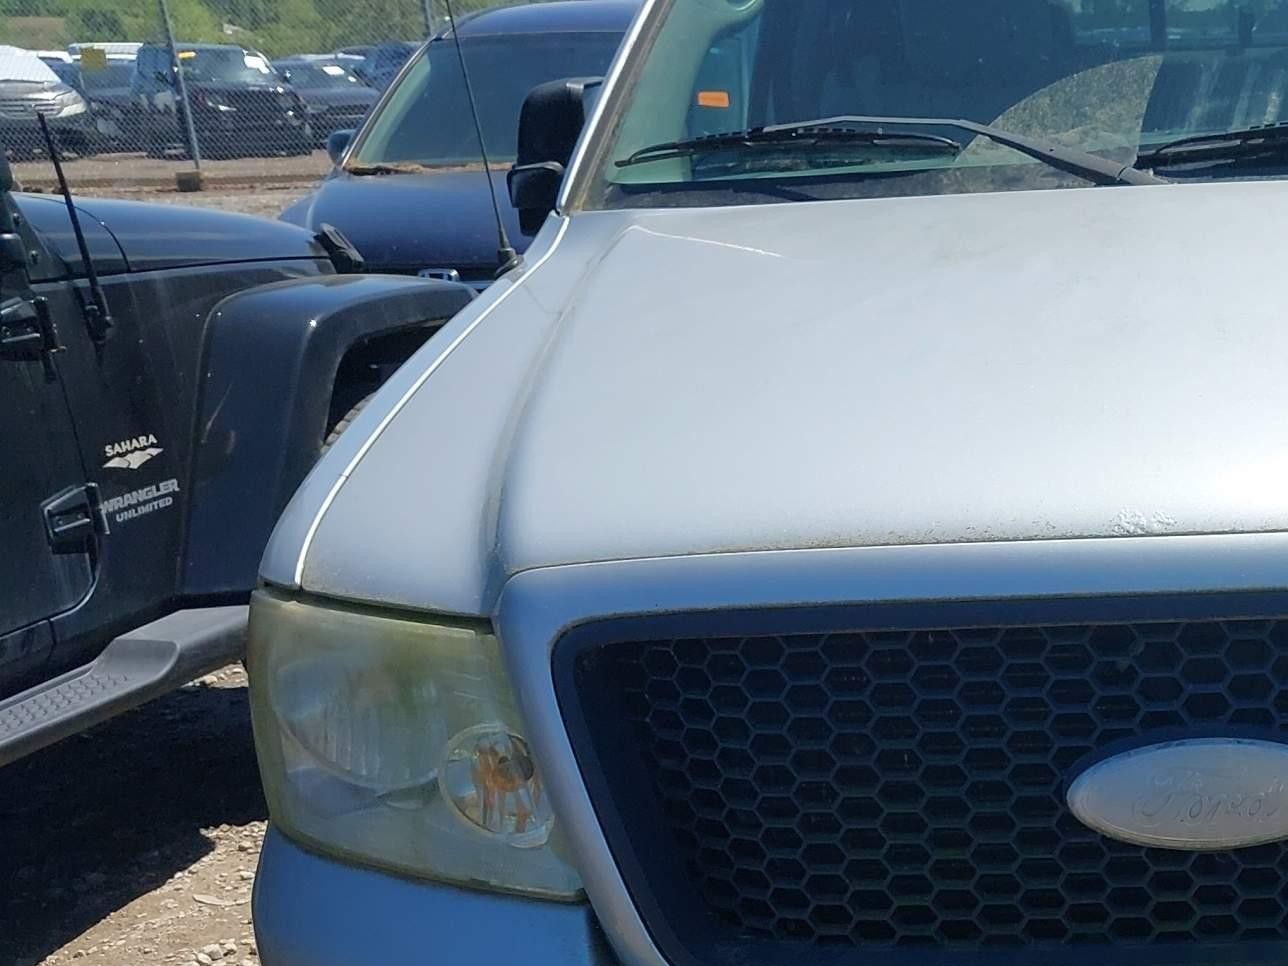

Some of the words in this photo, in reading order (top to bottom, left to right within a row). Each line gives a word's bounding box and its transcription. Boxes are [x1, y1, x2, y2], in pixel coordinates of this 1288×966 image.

[105, 433, 158, 457] SAHARA
[100, 478, 180, 513] WRANGLER
[116, 496, 173, 522] UNLIMITED
